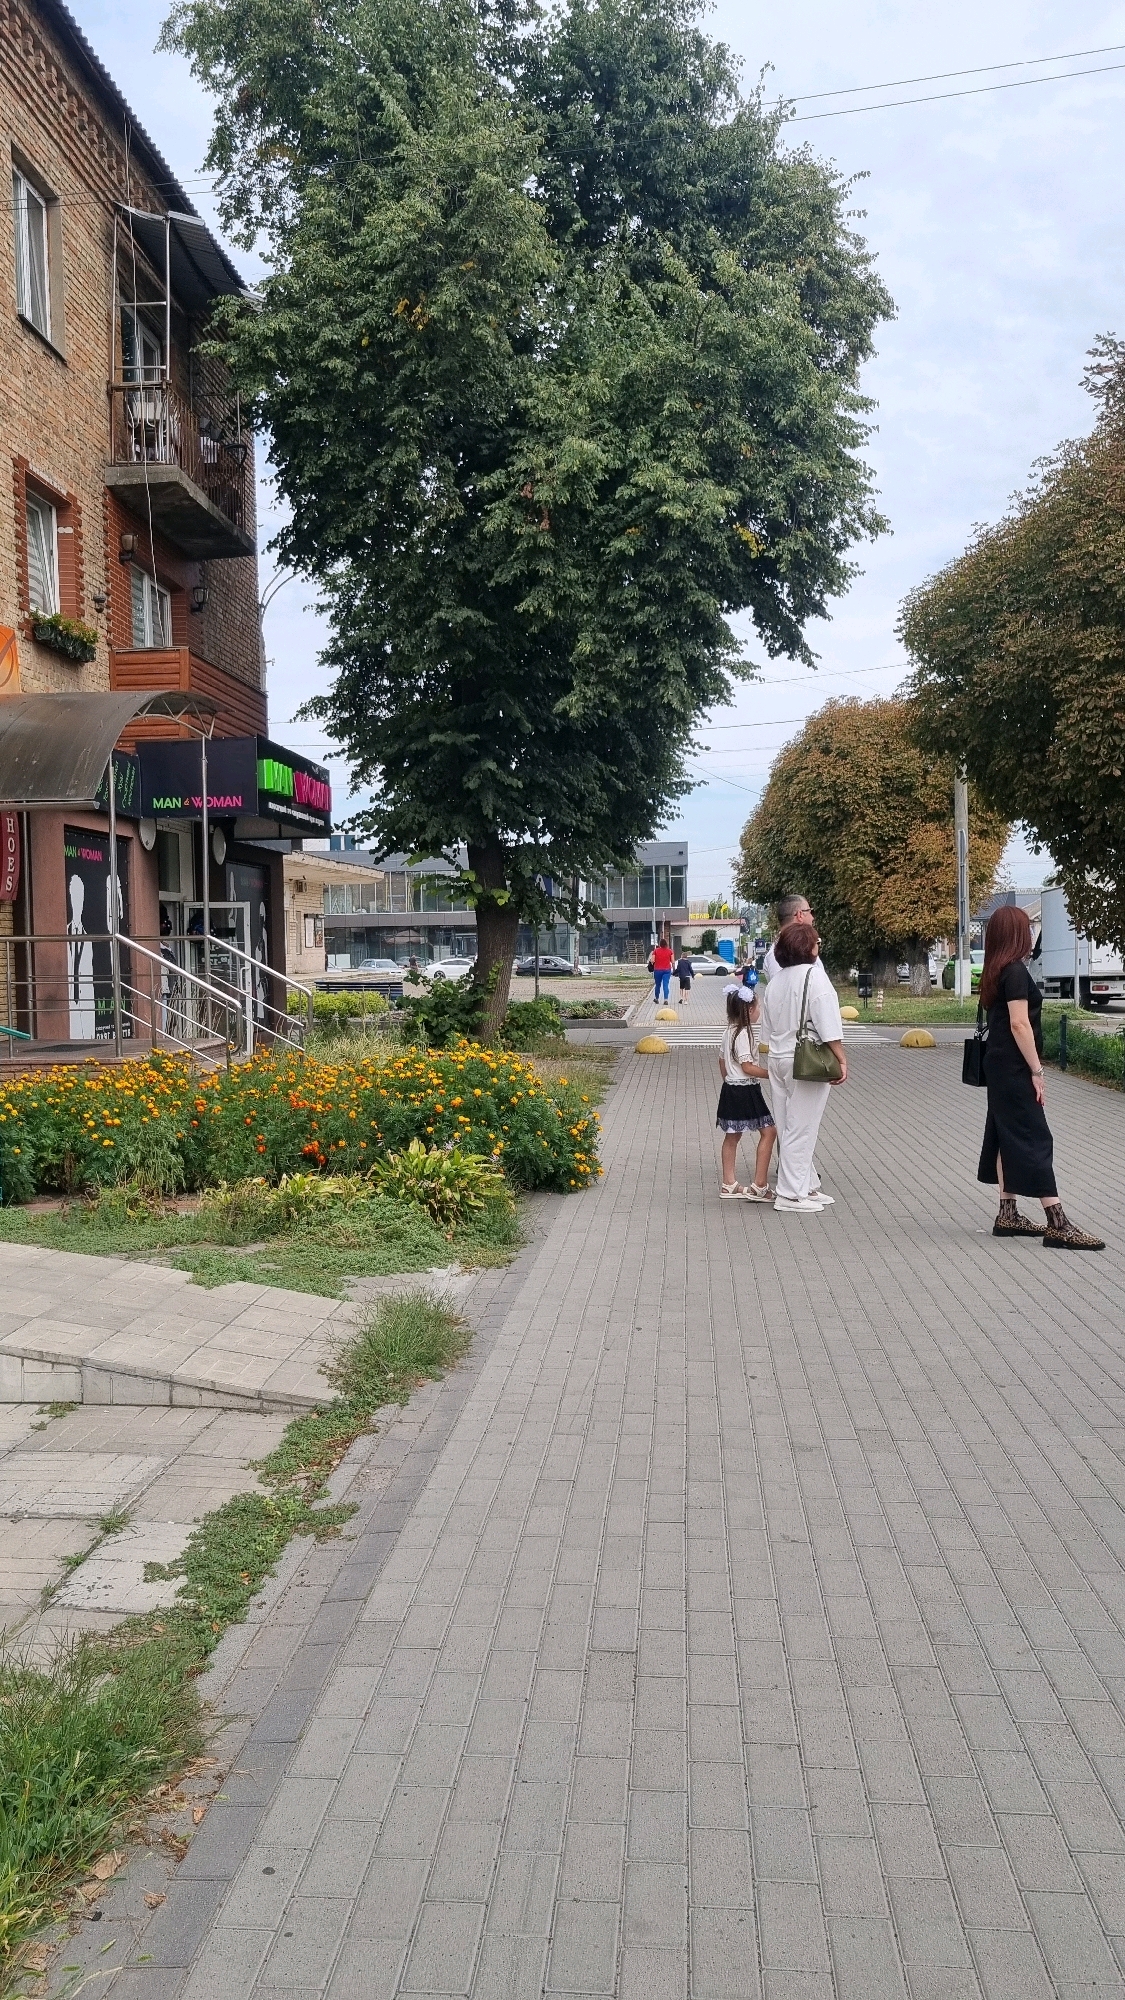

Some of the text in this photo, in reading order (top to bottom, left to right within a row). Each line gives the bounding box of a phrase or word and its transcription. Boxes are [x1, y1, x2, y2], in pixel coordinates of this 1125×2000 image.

[153, 797, 181, 808] MAN
[191, 795, 242, 808] WOMAN
[6, 811, 15, 891] HOES
[64, 845, 77, 858] MAN
[81, 847, 102, 861] WOMAN
